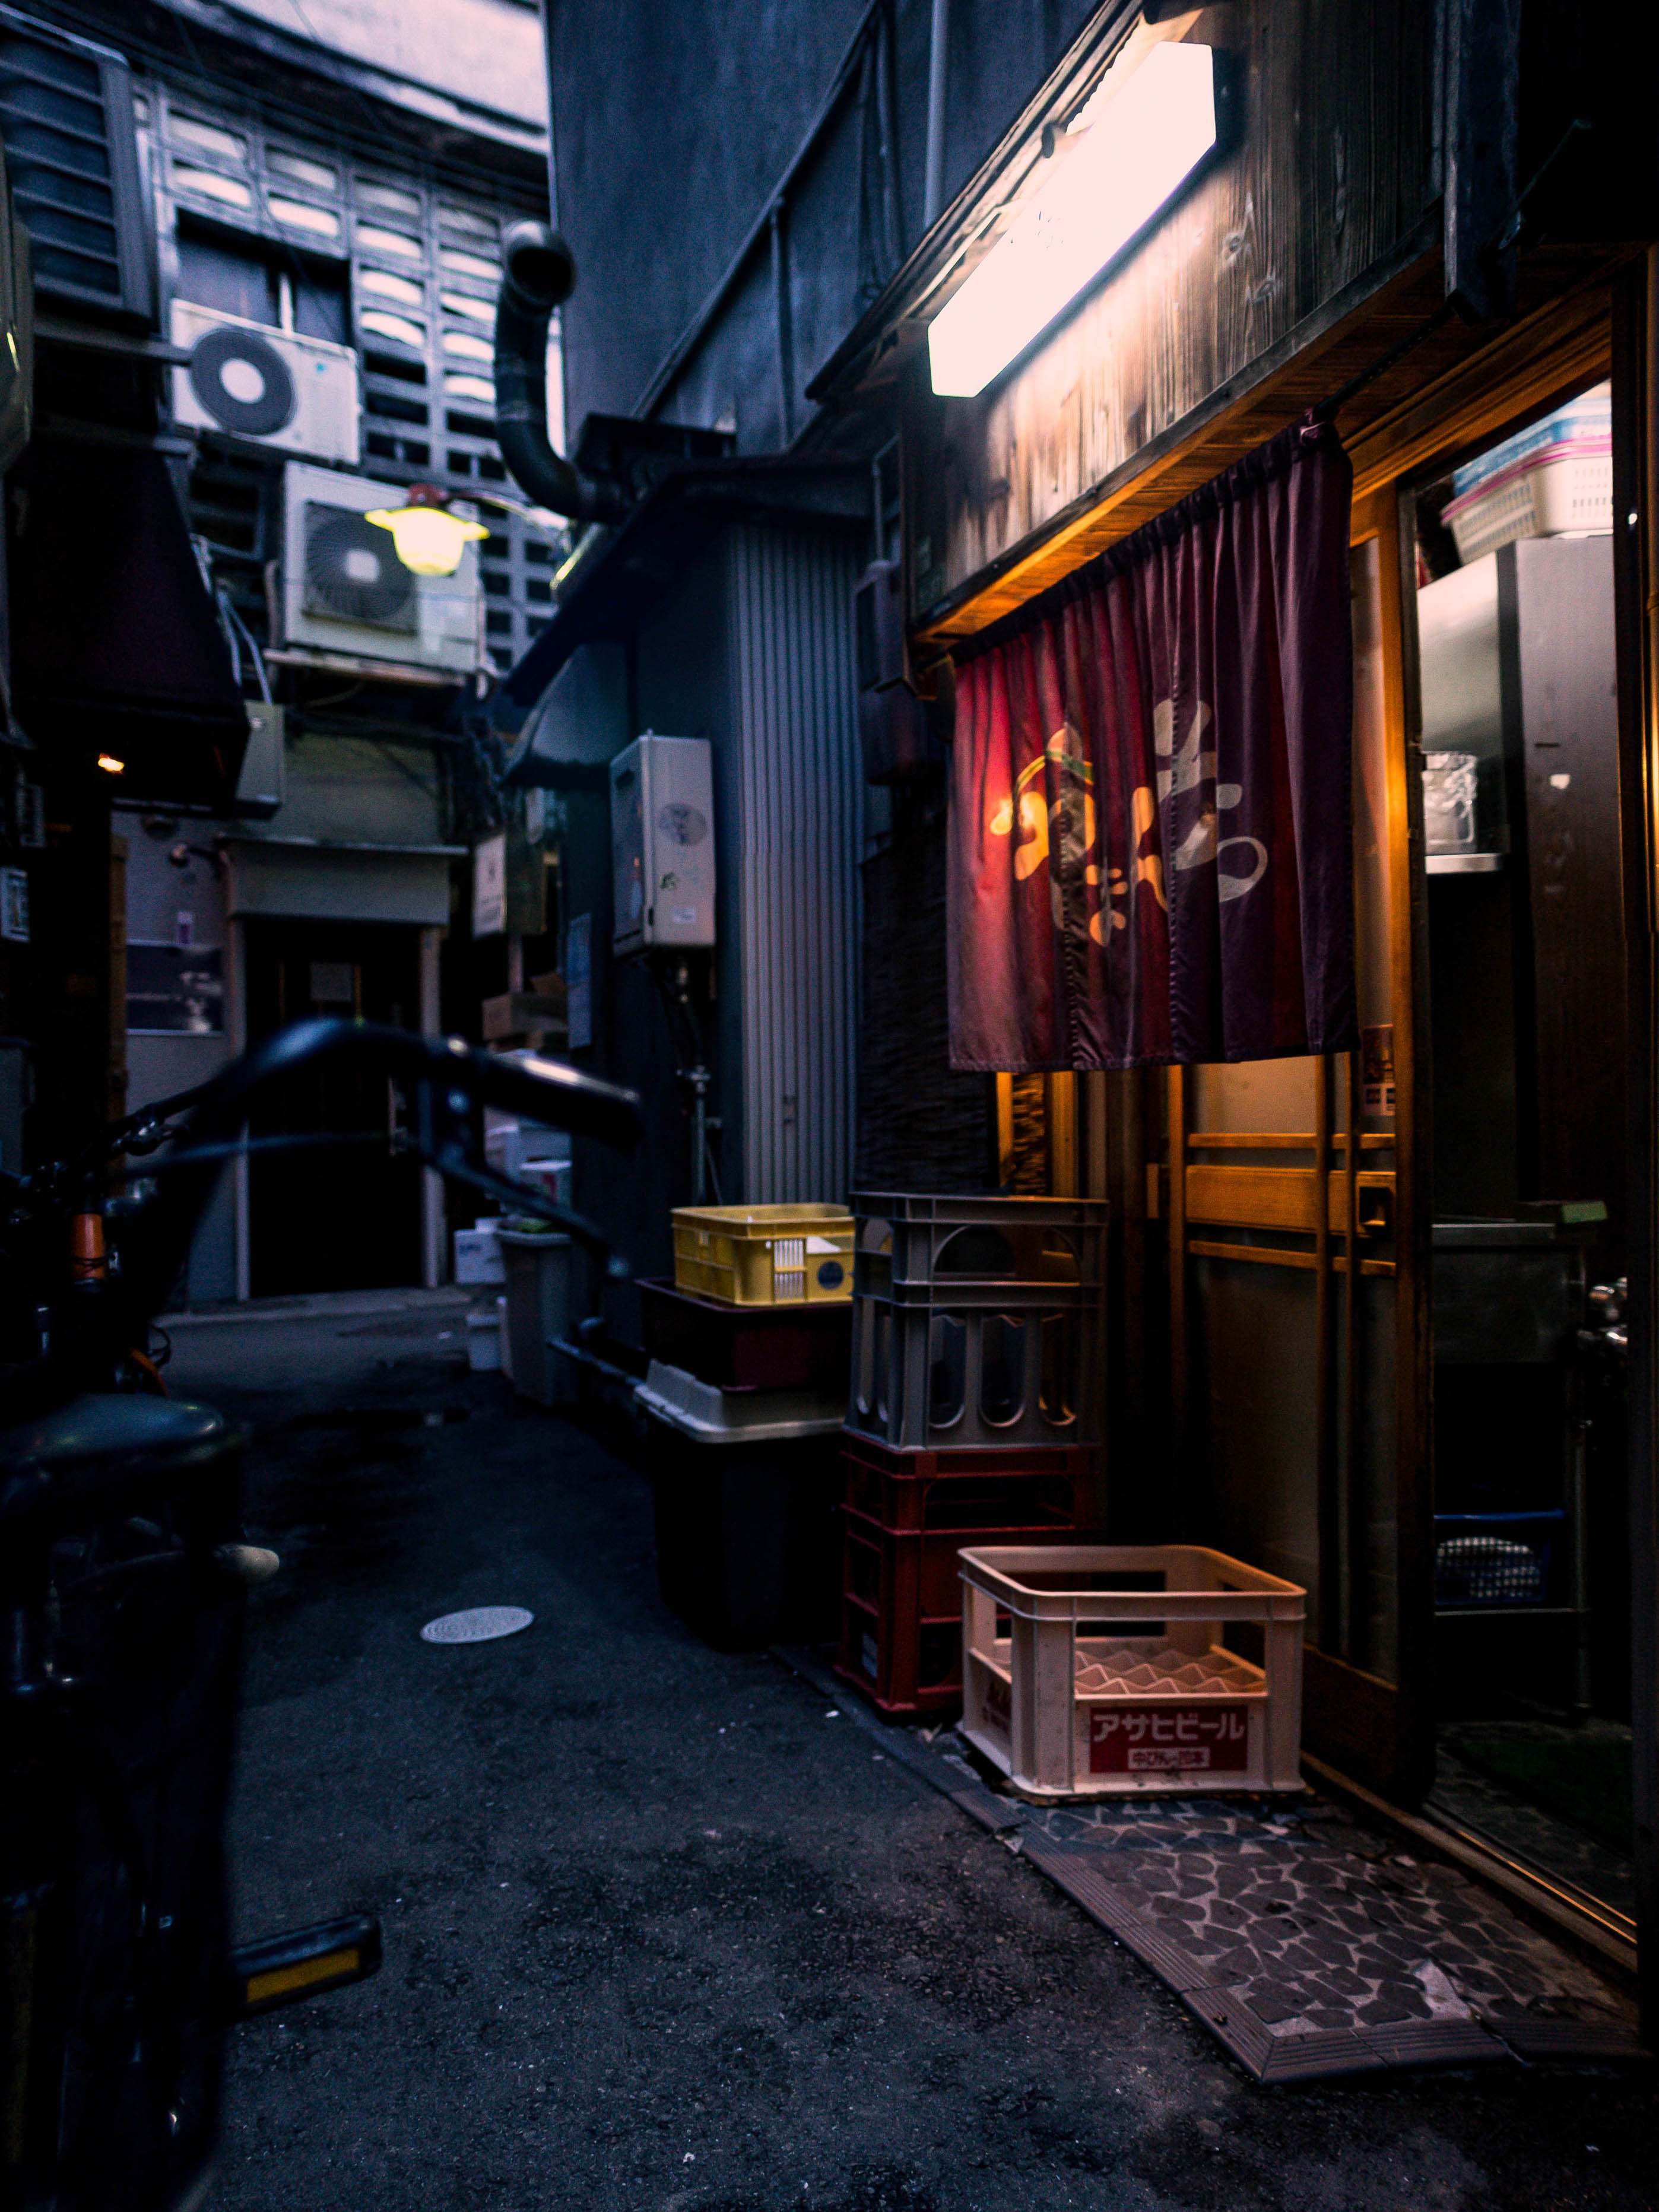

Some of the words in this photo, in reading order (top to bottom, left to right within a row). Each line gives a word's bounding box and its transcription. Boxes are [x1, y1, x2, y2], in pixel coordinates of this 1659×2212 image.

[1093, 1712, 1245, 1742] アサヒビール
